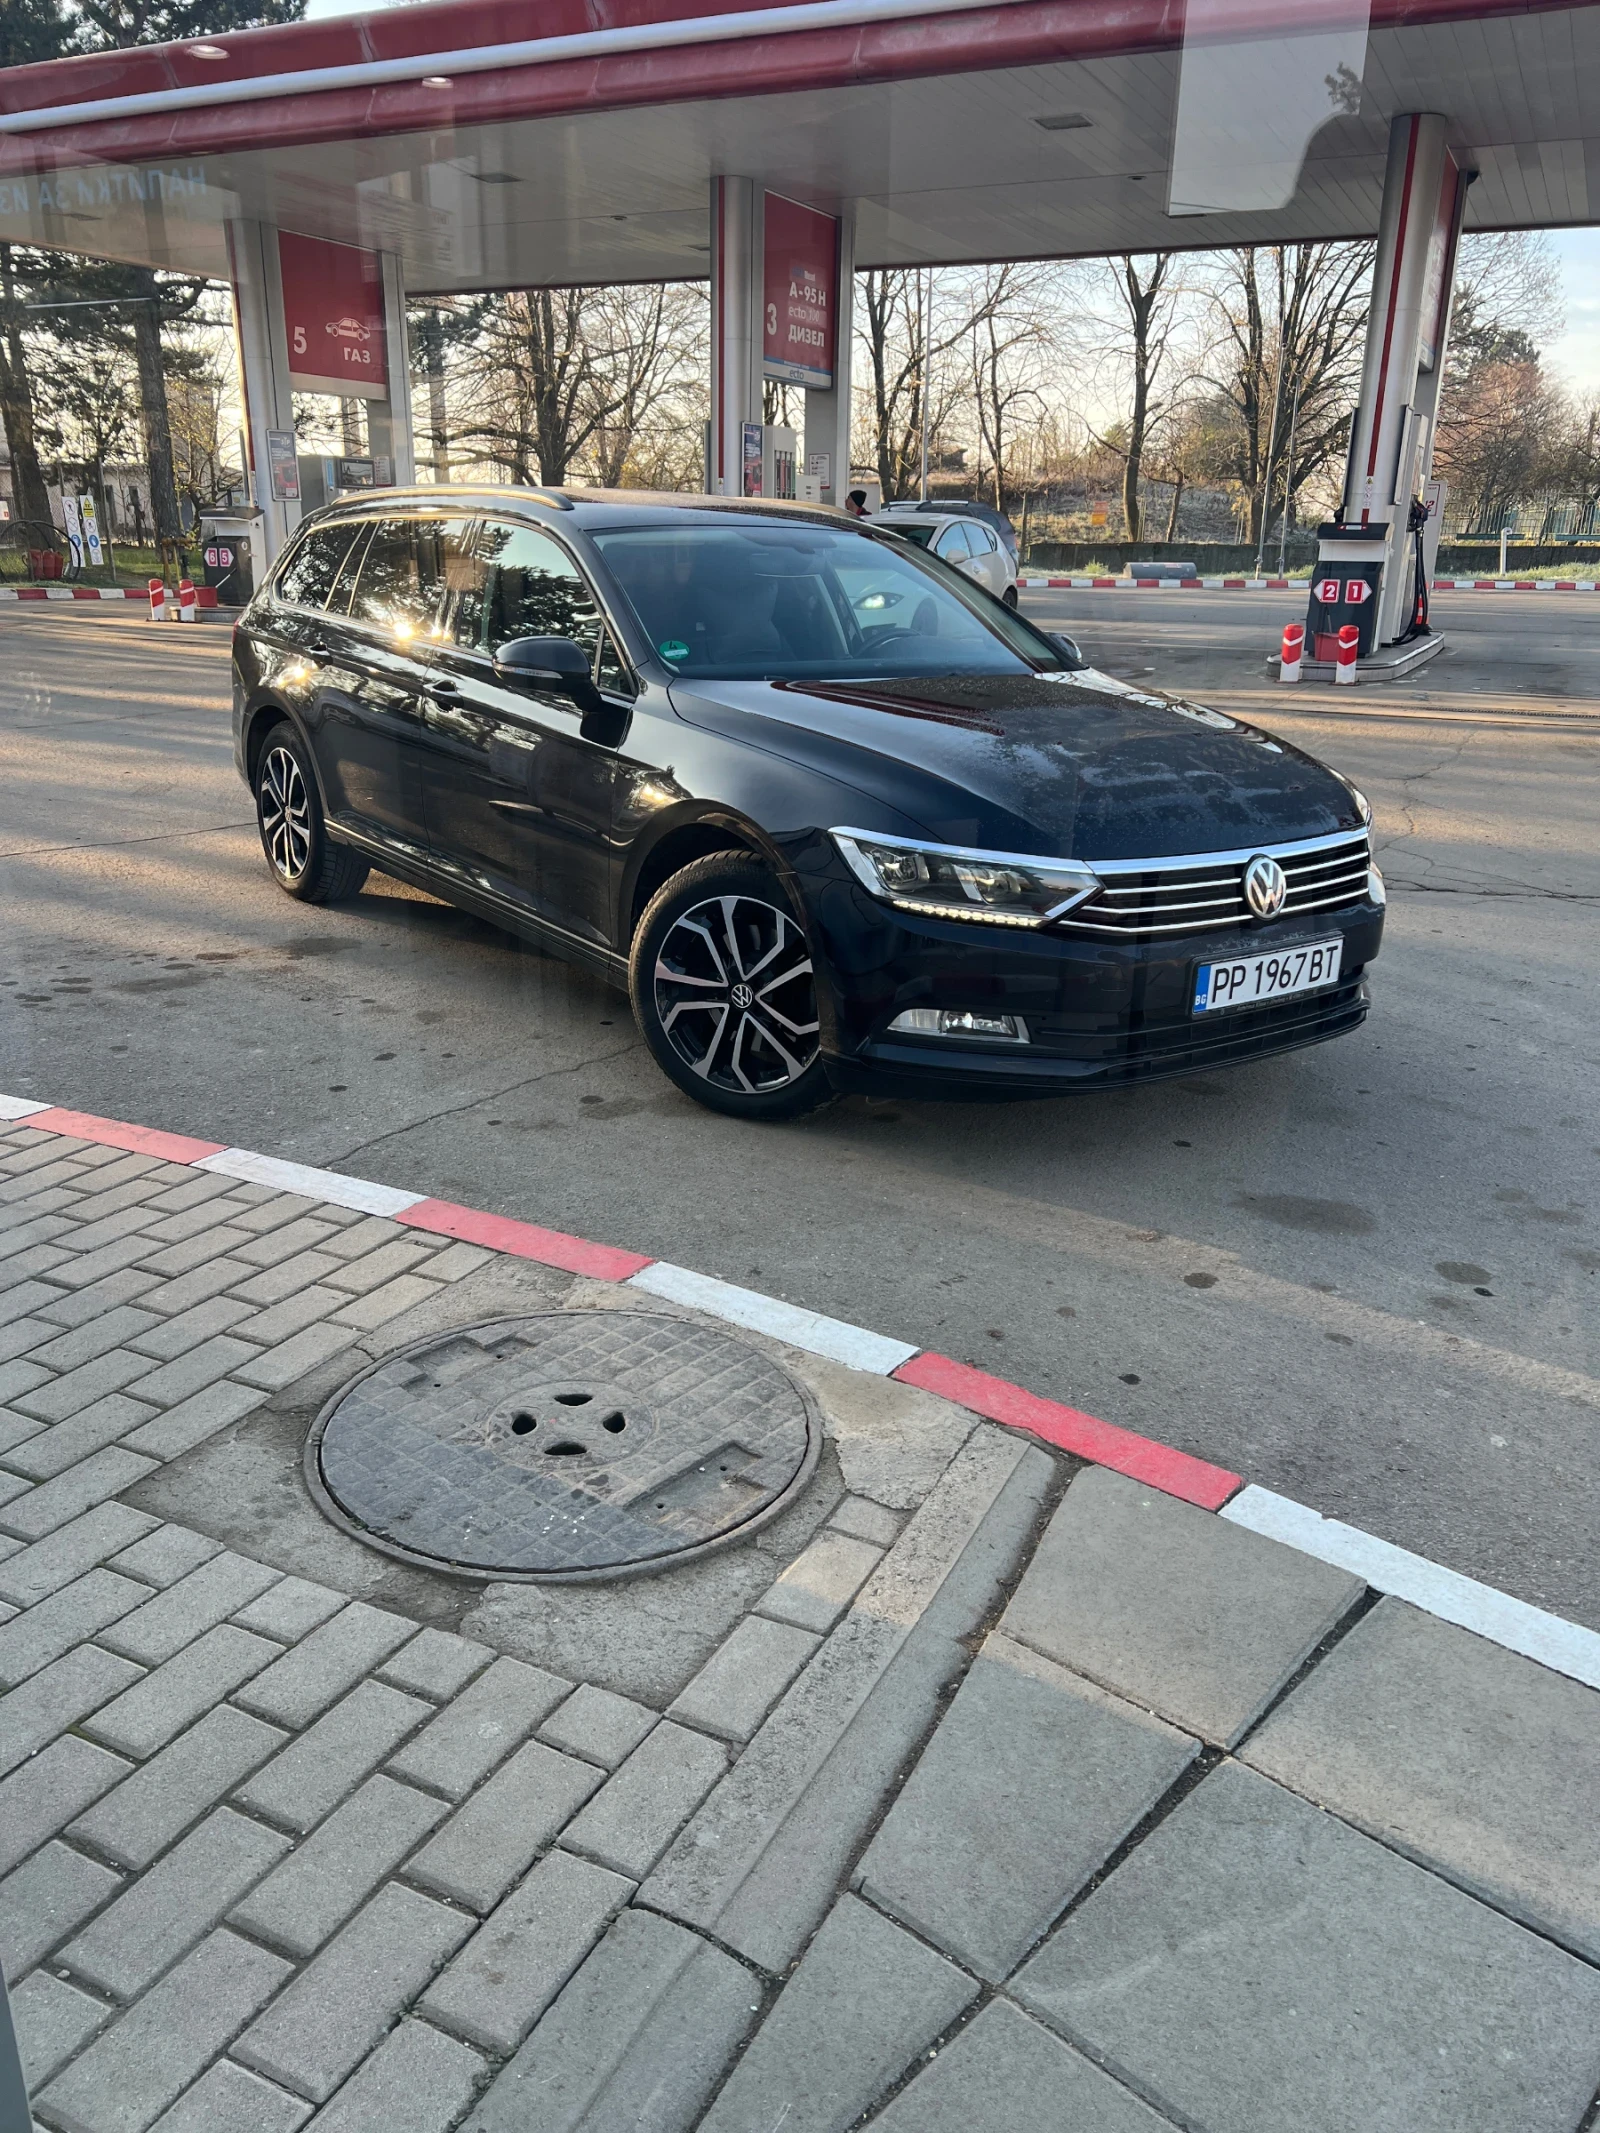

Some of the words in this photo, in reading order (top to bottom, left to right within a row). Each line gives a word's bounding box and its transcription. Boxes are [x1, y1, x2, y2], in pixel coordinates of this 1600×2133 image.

[766, 302, 777, 336] 3
[788, 305, 806, 320] ecto
[293, 325, 308, 355] 5
[788, 323, 825, 348] ДИЗЕЛ
[343, 346, 371, 364] ГАЗ
[789, 368, 804, 380] ecto
[209, 551, 216, 562] 6
[221, 552, 228, 563] 5
[1324, 584, 1336, 598] 2
[1352, 585, 1358, 598] 1
[1212, 964, 1246, 1003] PP
[1255, 952, 1308, 994] 1967
[1195, 994, 1207, 1006] BG
